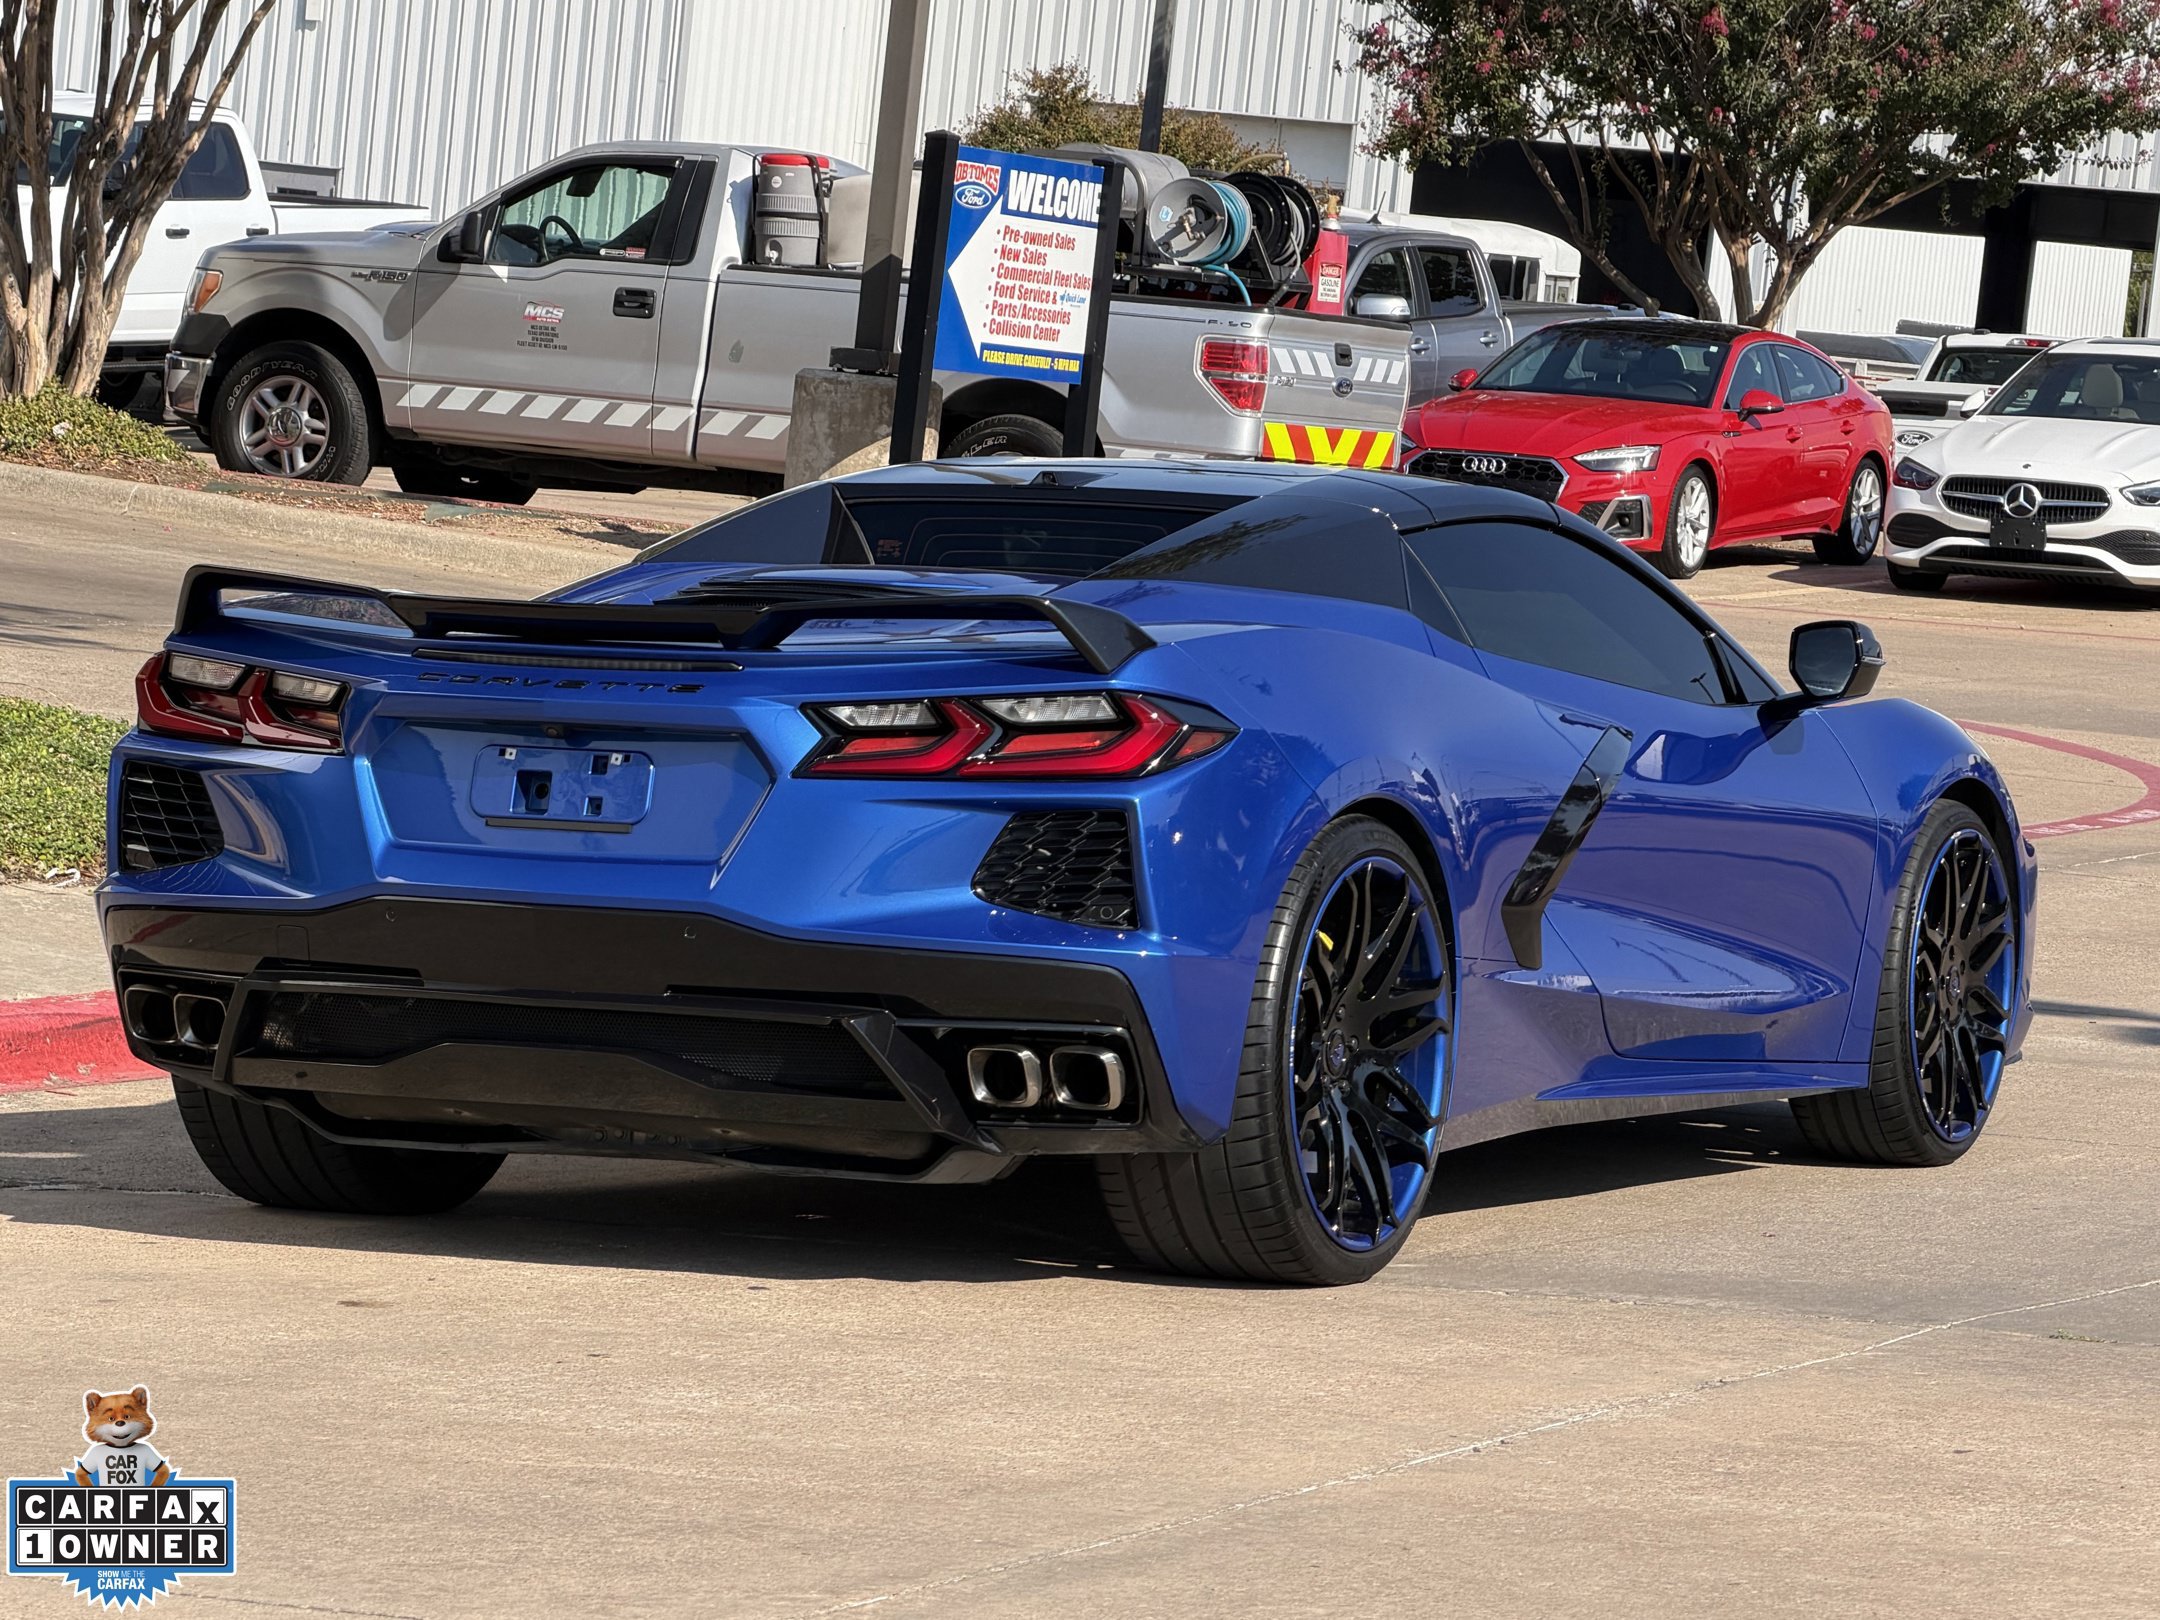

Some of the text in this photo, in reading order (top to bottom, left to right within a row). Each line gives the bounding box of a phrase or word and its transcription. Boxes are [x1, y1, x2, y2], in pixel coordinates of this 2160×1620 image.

[954, 162, 1000, 193] OB TOMES
[962, 188, 985, 205] Ford
[1008, 170, 1102, 222] WELCOME
[1003, 225, 1076, 251] Pre-owned Sales
[1000, 244, 1048, 266] New Sales
[996, 262, 1091, 290] Commercial Fleet Sales
[1321, 278, 1340, 288] GASOLINE
[994, 281, 1058, 304] Ford Service &
[524, 304, 564, 319] MCS
[991, 300, 1071, 325] Parts/Accessories
[989, 318, 1060, 342] Collision Center
[983, 350, 1005, 364] PLEASE
[226, 360, 318, 411] GOODYEAR
[417, 672, 705, 693] CORVETTE
